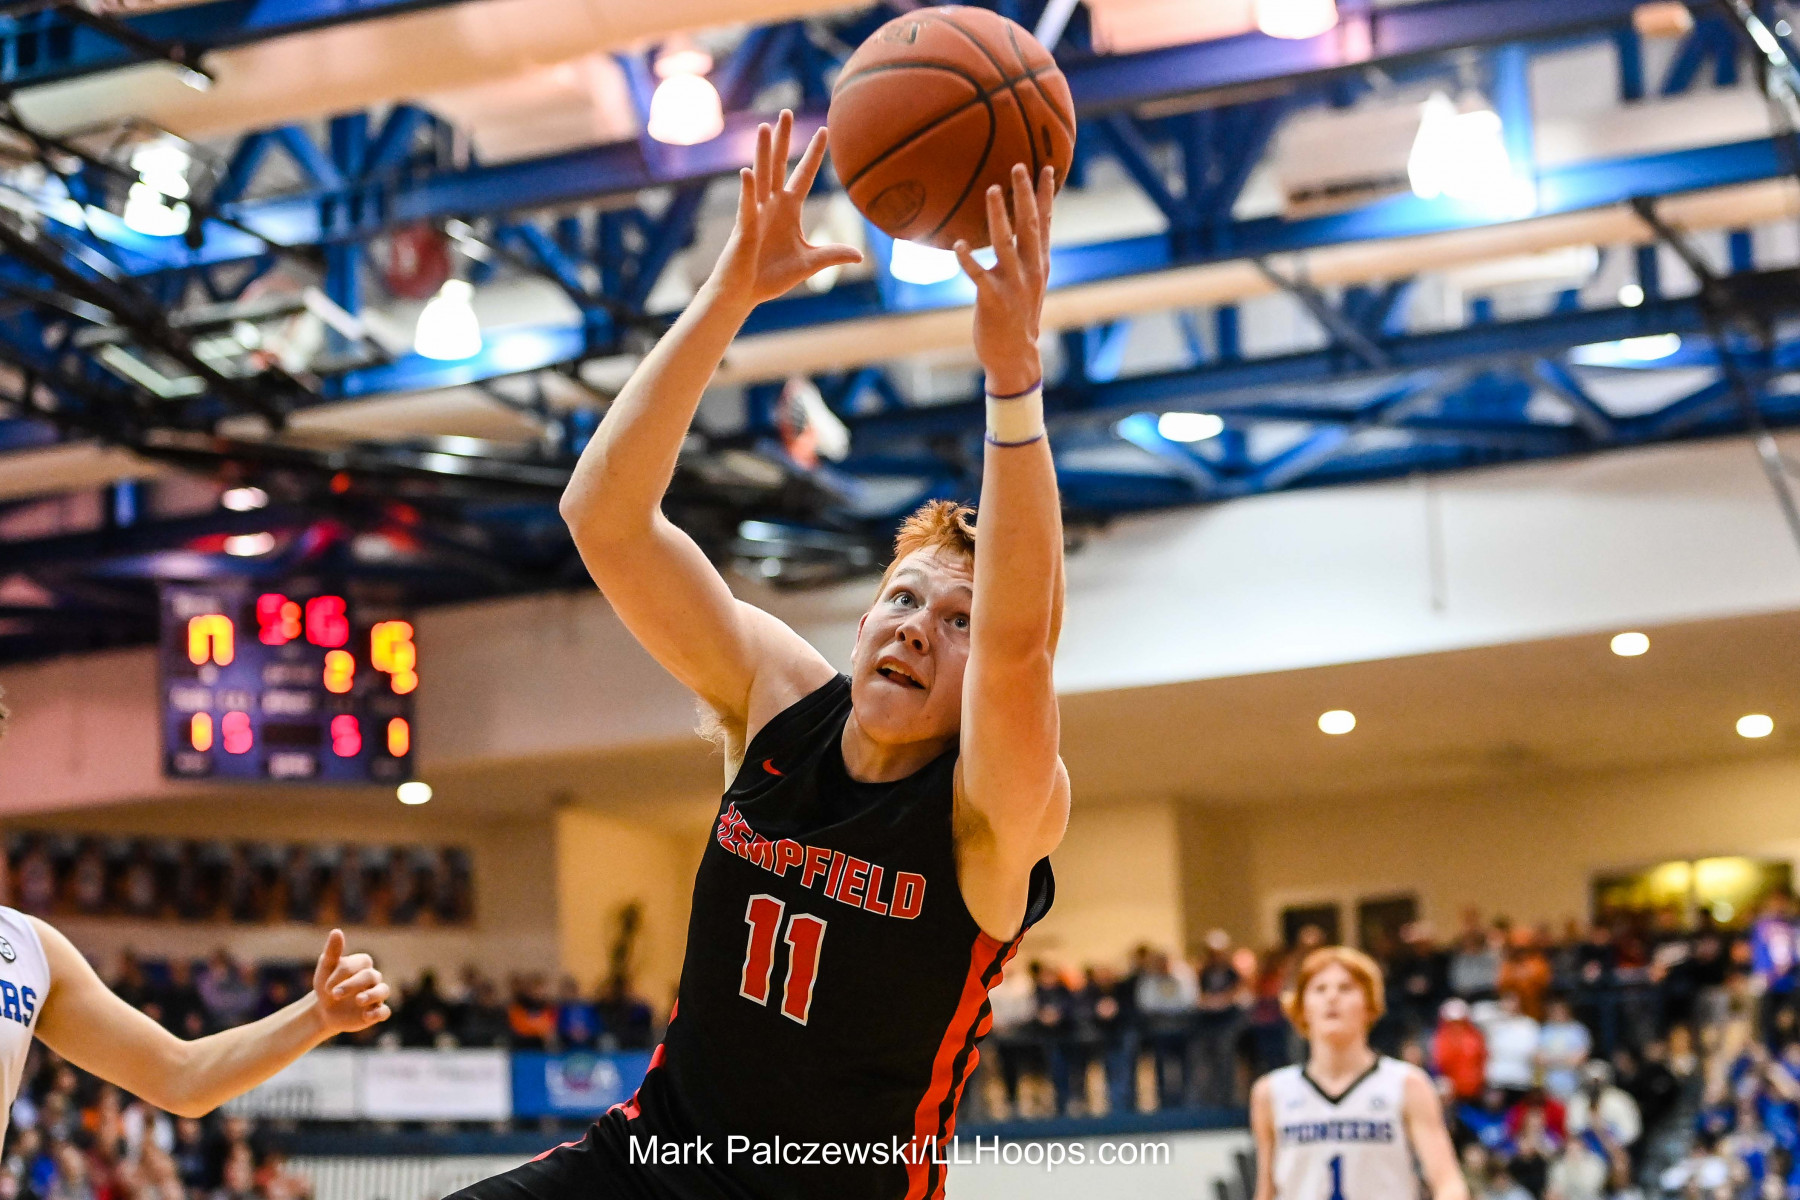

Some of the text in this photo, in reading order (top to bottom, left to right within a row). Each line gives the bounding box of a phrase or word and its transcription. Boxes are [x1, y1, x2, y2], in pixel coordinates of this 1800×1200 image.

[739, 894, 828, 1026] 11
[0, 979, 36, 1027] RS
[1329, 1153, 1345, 1200] 1
